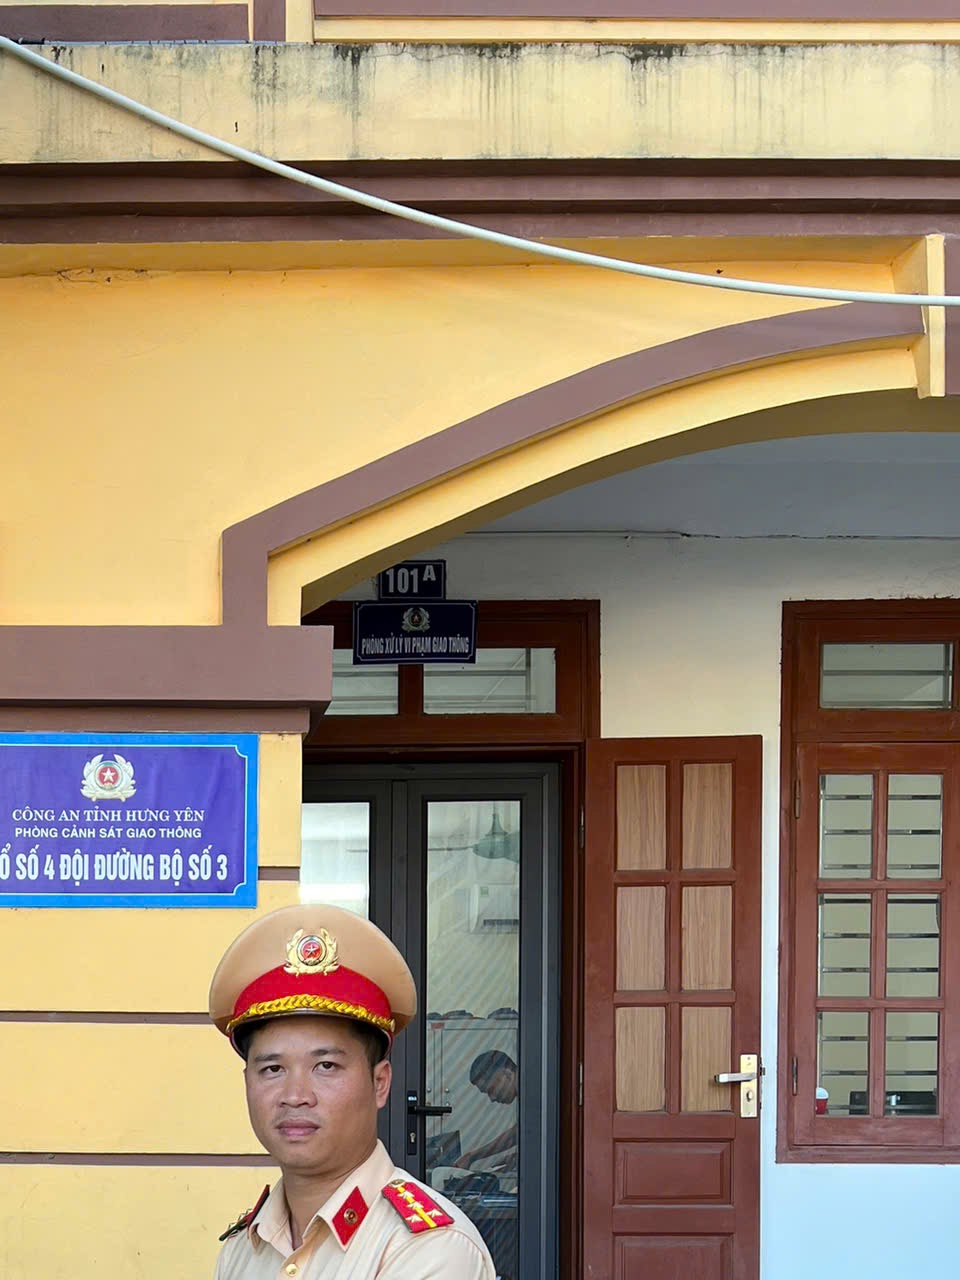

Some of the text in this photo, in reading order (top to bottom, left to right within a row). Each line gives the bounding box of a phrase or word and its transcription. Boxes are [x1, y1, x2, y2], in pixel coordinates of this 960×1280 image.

[404, 637, 411, 654] VI
[412, 637, 431, 657] PHẠM
[432, 636, 448, 653] GIAO
[12, 805, 205, 822] CÔNG AN TỈNH HƯNG YÊN
[15, 825, 202, 839] PHÒNG CẢNH SÁT GIAO THÔNG
[16, 844, 40, 880] SỐ
[44, 854, 55, 880] 4
[59, 849, 89, 886] ĐỘI
[94, 848, 154, 880] ĐƯỜNG
[159, 849, 183, 886] BỘ
[188, 844, 212, 880] SỐ
[216, 854, 228, 880] 3
